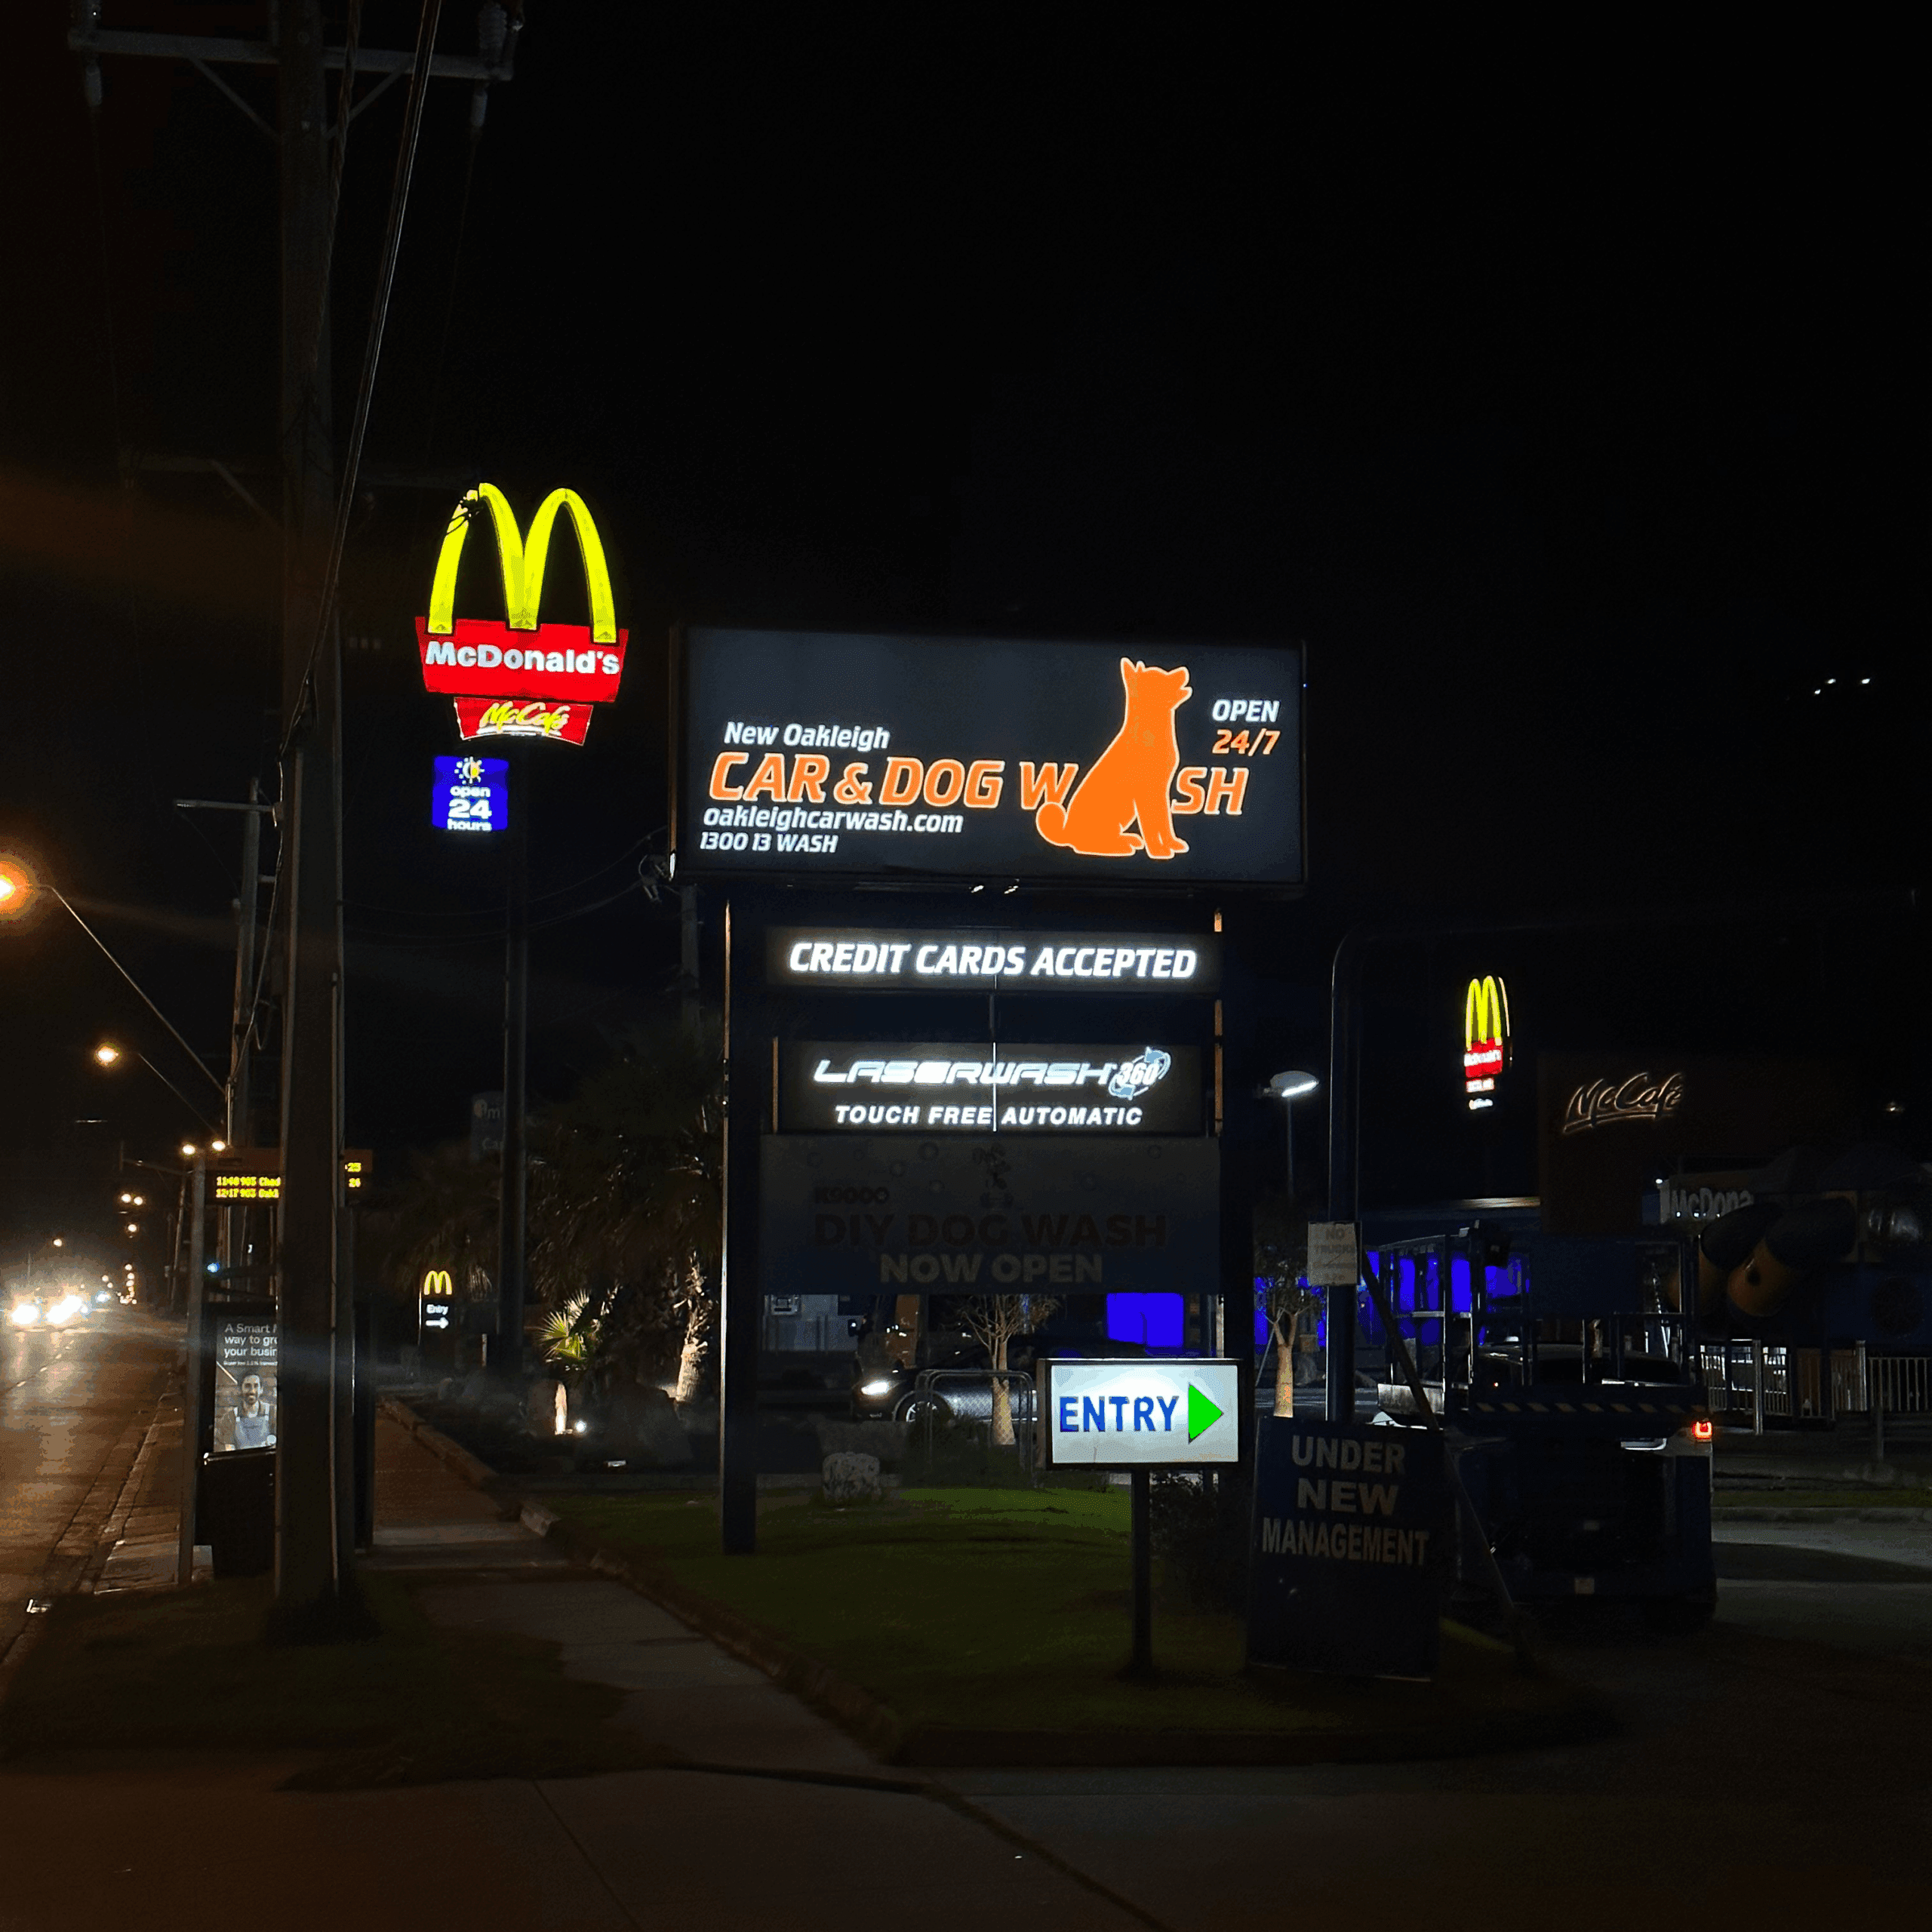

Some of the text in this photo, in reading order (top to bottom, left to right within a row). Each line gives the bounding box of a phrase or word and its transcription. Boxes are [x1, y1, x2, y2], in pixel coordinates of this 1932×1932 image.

[425, 640, 620, 675] McDonald's
[1211, 699, 1280, 722] OPEN
[724, 721, 891, 752] New Oakleigh
[1211, 728, 1281, 757] 24/7
[450, 786, 491, 798] open
[708, 751, 1250, 816] CAR & DOG WSH
[448, 798, 493, 820] 24
[703, 804, 964, 833] oakleighcarwash.com
[447, 818, 493, 832] hours
[700, 831, 839, 854] 1300 13 WASH
[789, 942, 1198, 980] CREDIT CARDS ACCEPTED
[813, 1059, 1160, 1086] LASERWASH 360
[835, 1105, 1143, 1127] TOUCH FREE AUTOMATIC
[1563, 1072, 1686, 1133] McCafé
[814, 1214, 1168, 1248] DIY DOG WASH
[1325, 1227, 1346, 1241] NO
[879, 1254, 1103, 1284] NOW OPEN
[426, 1303, 449, 1315] Entry
[224, 1323, 234, 1334] A
[236, 1323, 271, 1334] Smart
[224, 1336, 247, 1346] way
[249, 1335, 261, 1344] to
[223, 1348, 248, 1358] your
[1059, 1395, 1180, 1432] ENTRY
[1291, 1434, 1406, 1475] UNDER
[1296, 1477, 1399, 1517] NEW
[1261, 1515, 1430, 1567] MANAGEMENT
